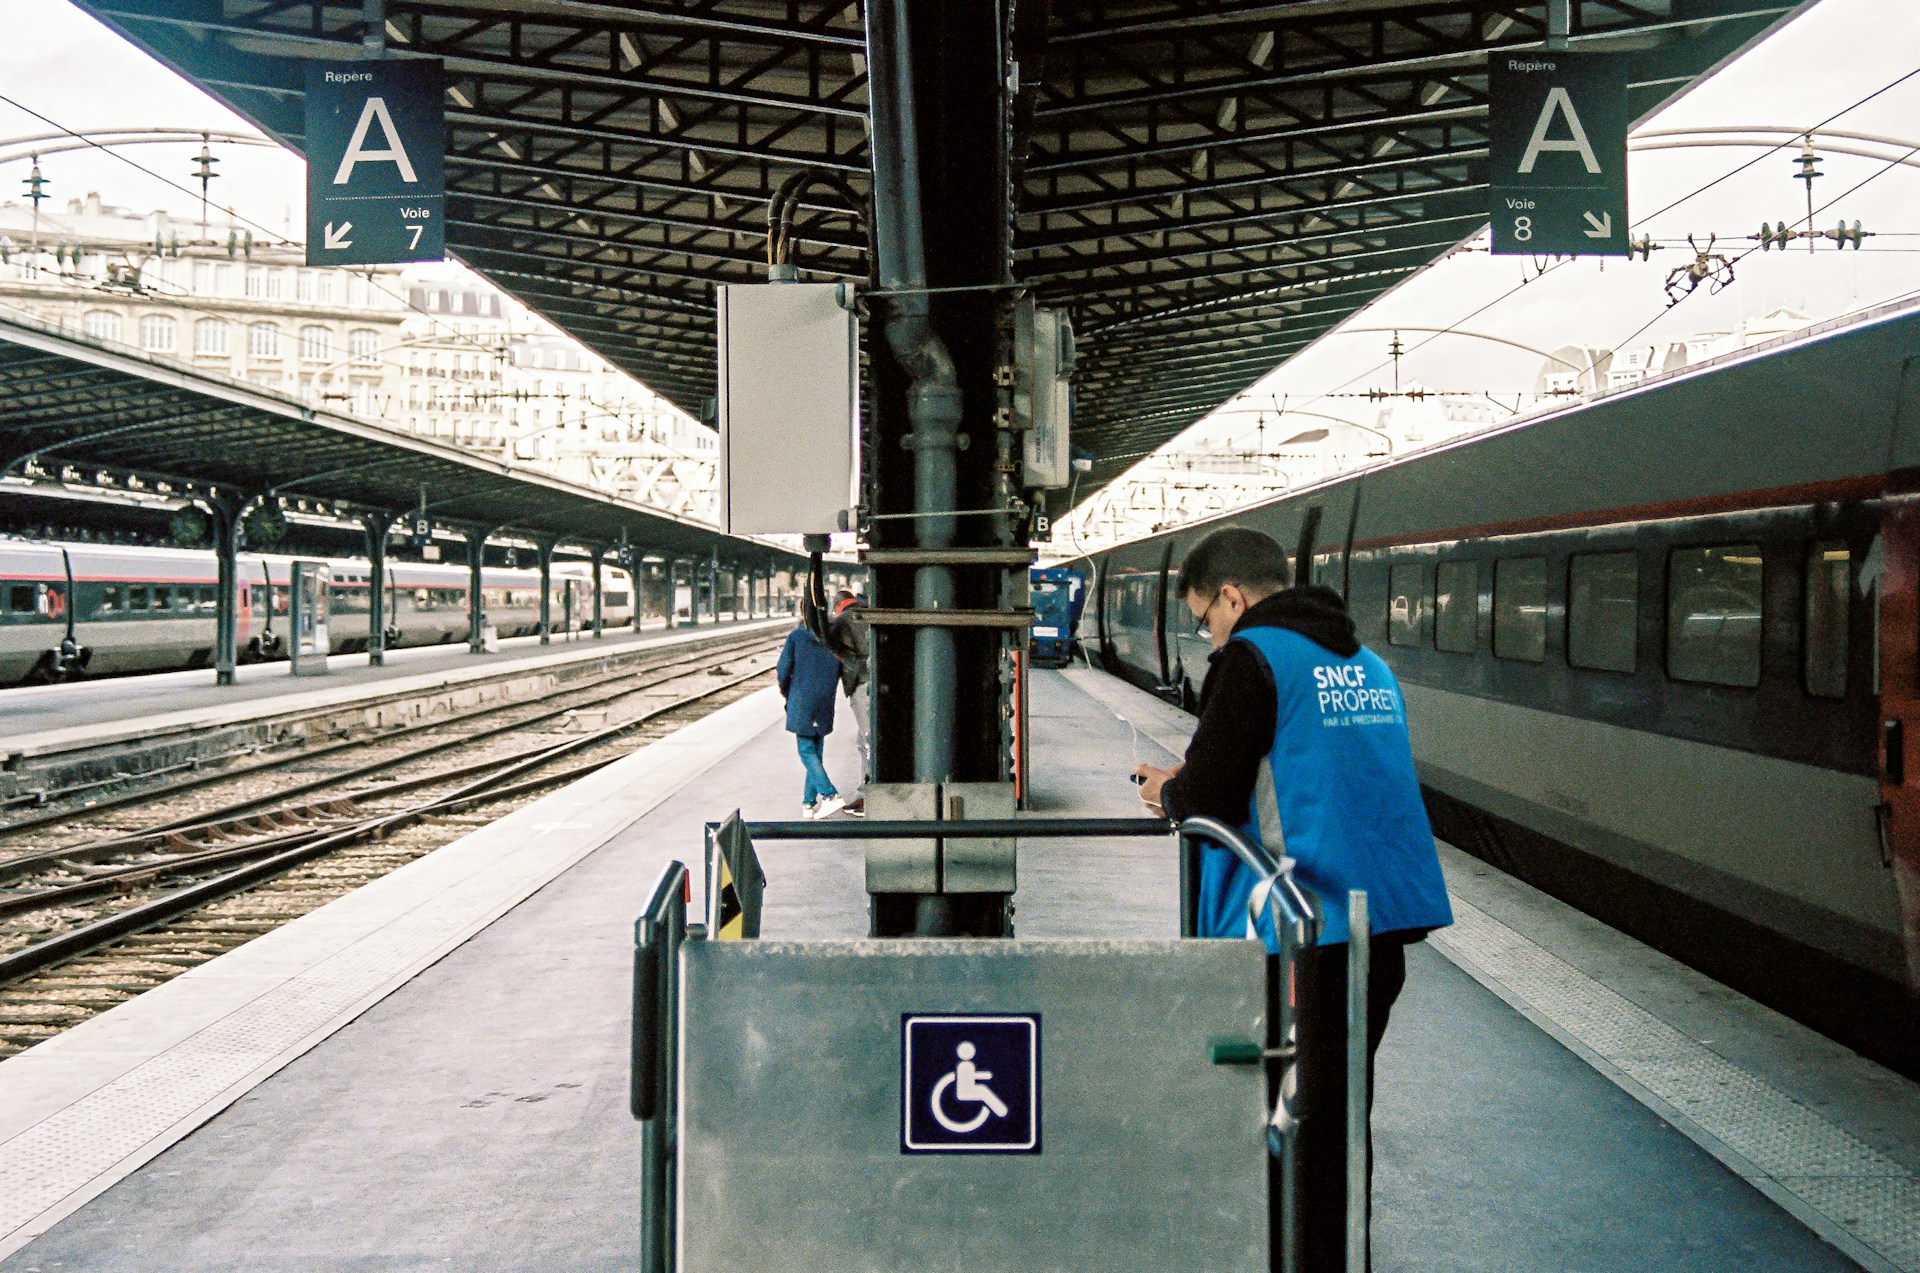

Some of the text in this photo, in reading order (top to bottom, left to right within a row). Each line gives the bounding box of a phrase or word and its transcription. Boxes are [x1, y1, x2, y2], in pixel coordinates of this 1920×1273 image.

[1508, 60, 1556, 73] Repère
[325, 71, 373, 83] Repère
[1517, 87, 1602, 174] A
[333, 97, 418, 185] A
[1506, 198, 1536, 209] Voie
[400, 207, 431, 219] Voie
[1514, 216, 1532, 241] 8
[405, 225, 424, 250] 7
[416, 520, 429, 535] B
[1037, 516, 1049, 531] B
[1313, 665, 1366, 689] SNCF
